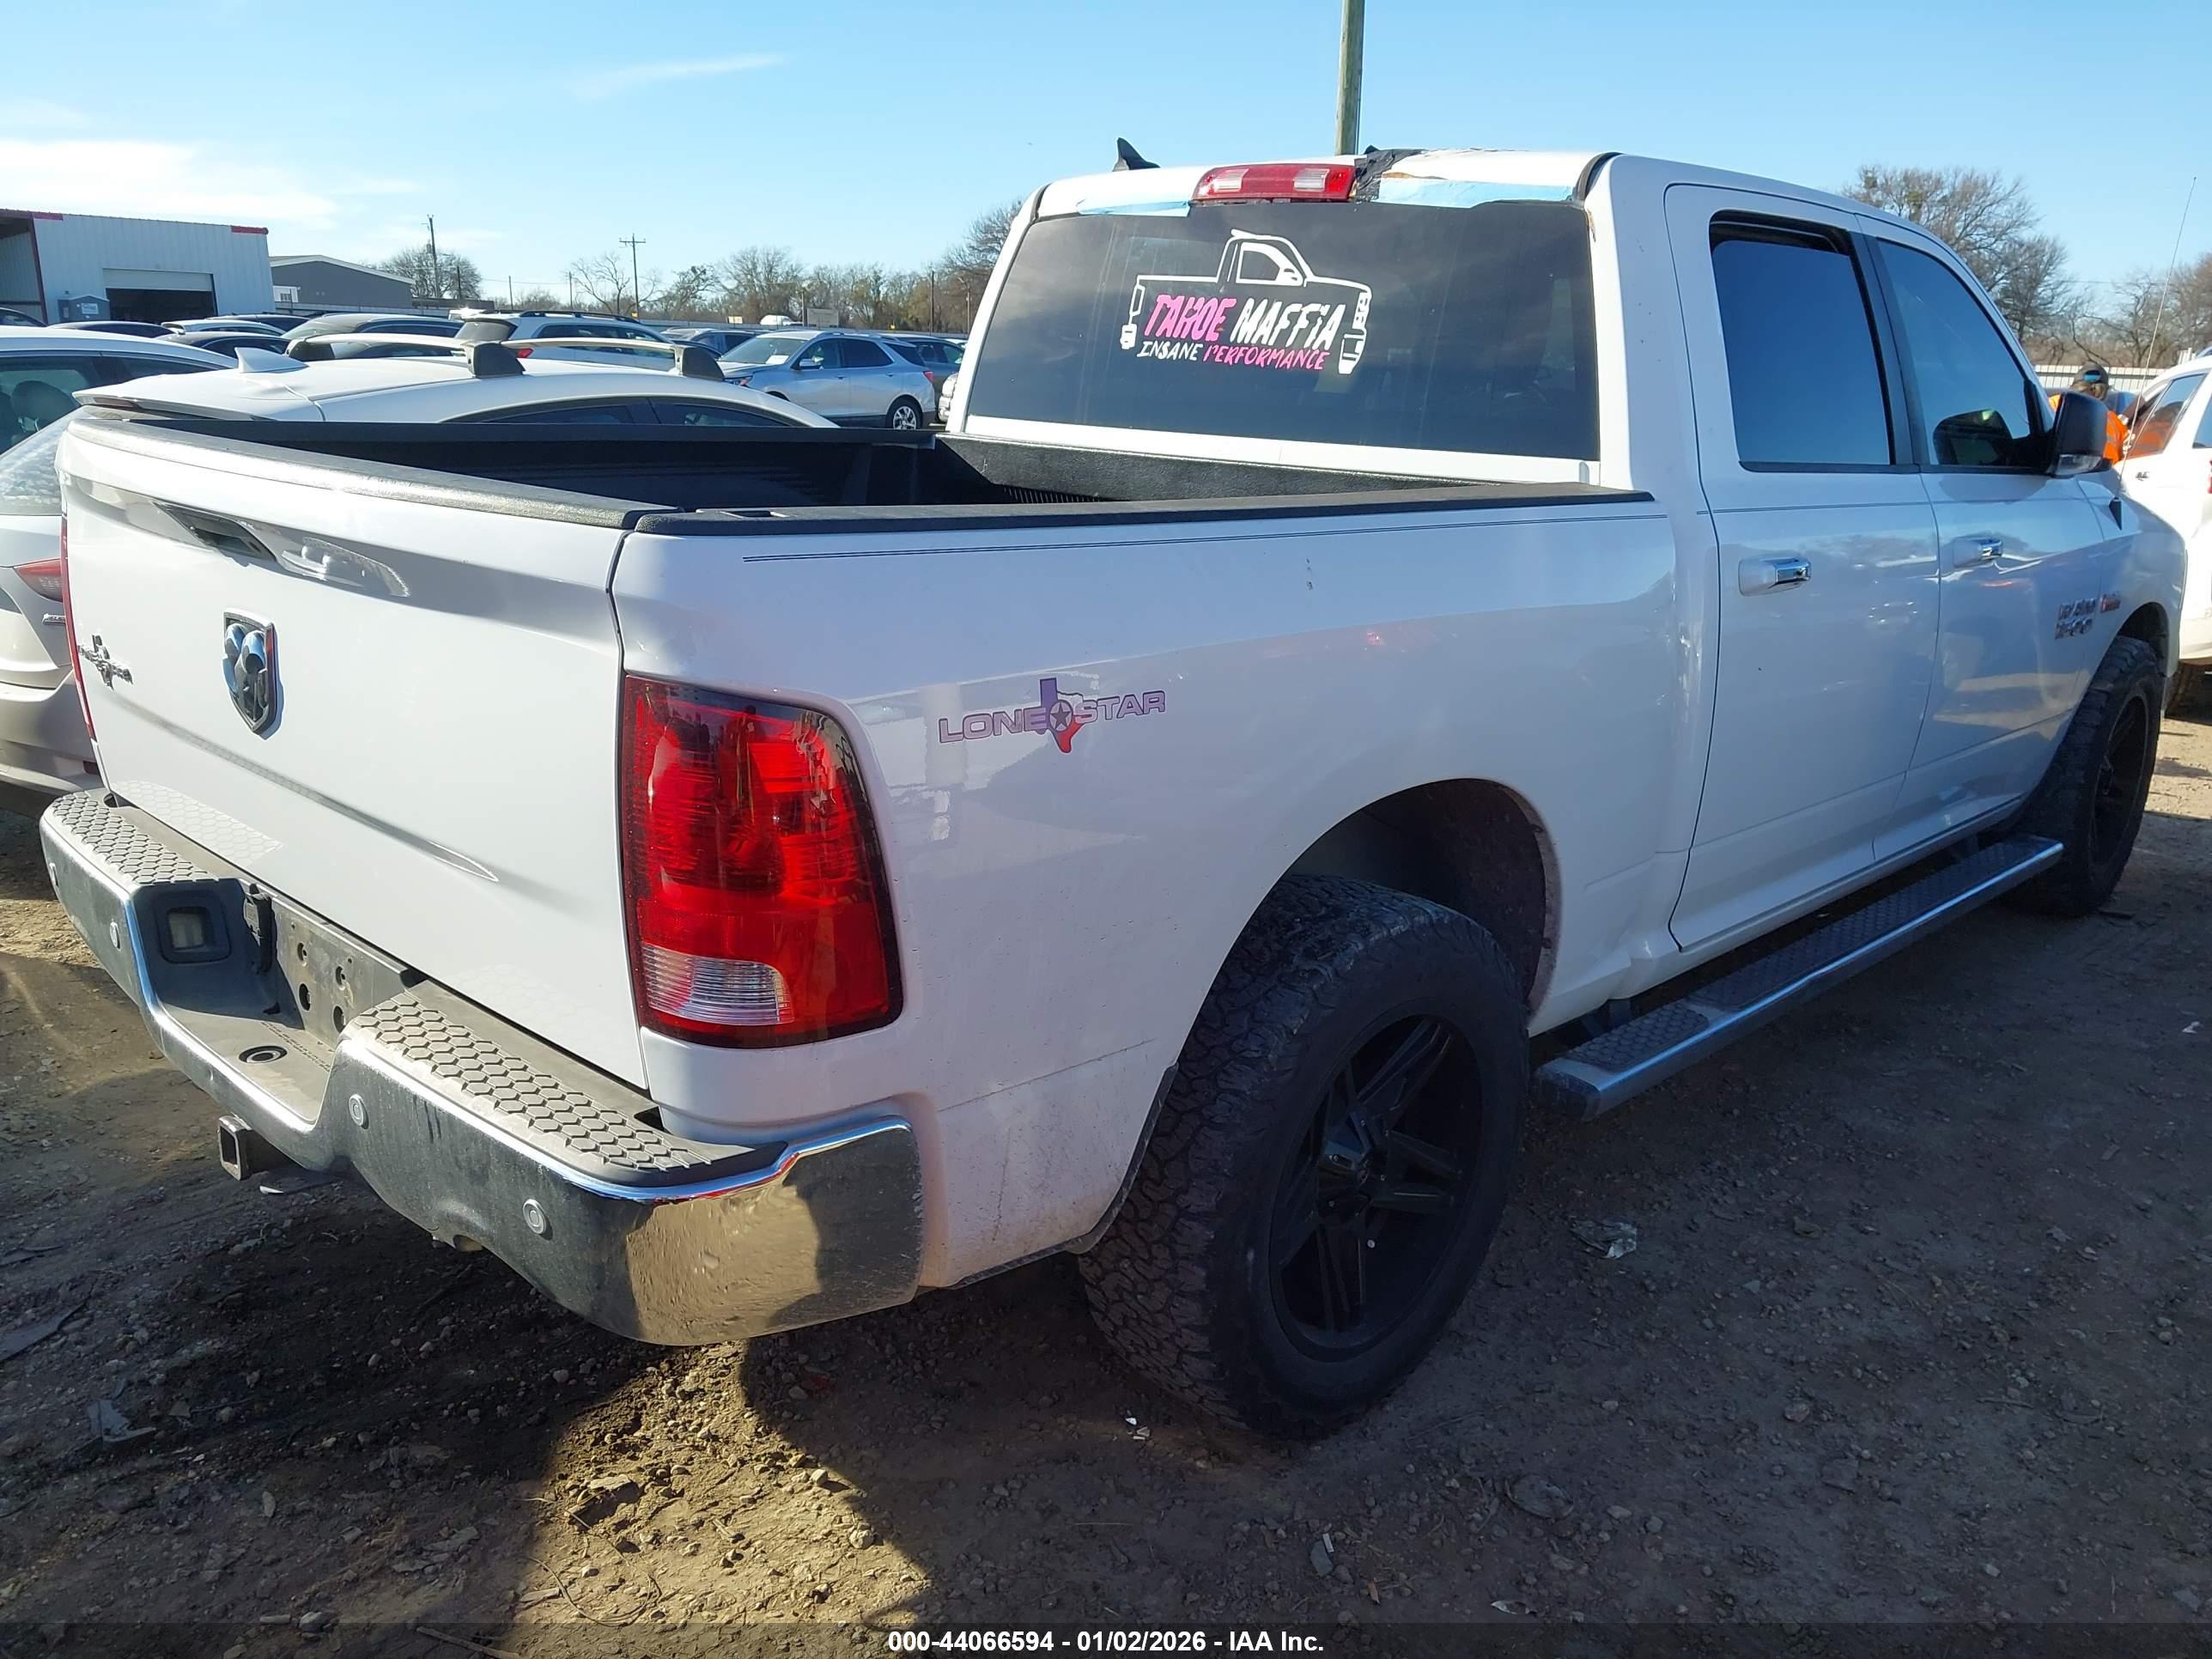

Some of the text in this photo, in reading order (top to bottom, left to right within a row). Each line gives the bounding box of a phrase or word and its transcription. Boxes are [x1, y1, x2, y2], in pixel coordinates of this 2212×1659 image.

[1145, 294, 1237, 342] TAHOE
[1137, 341, 1331, 370] INSANE PERFORMANCE
[939, 690, 1166, 744] LONE STAR
